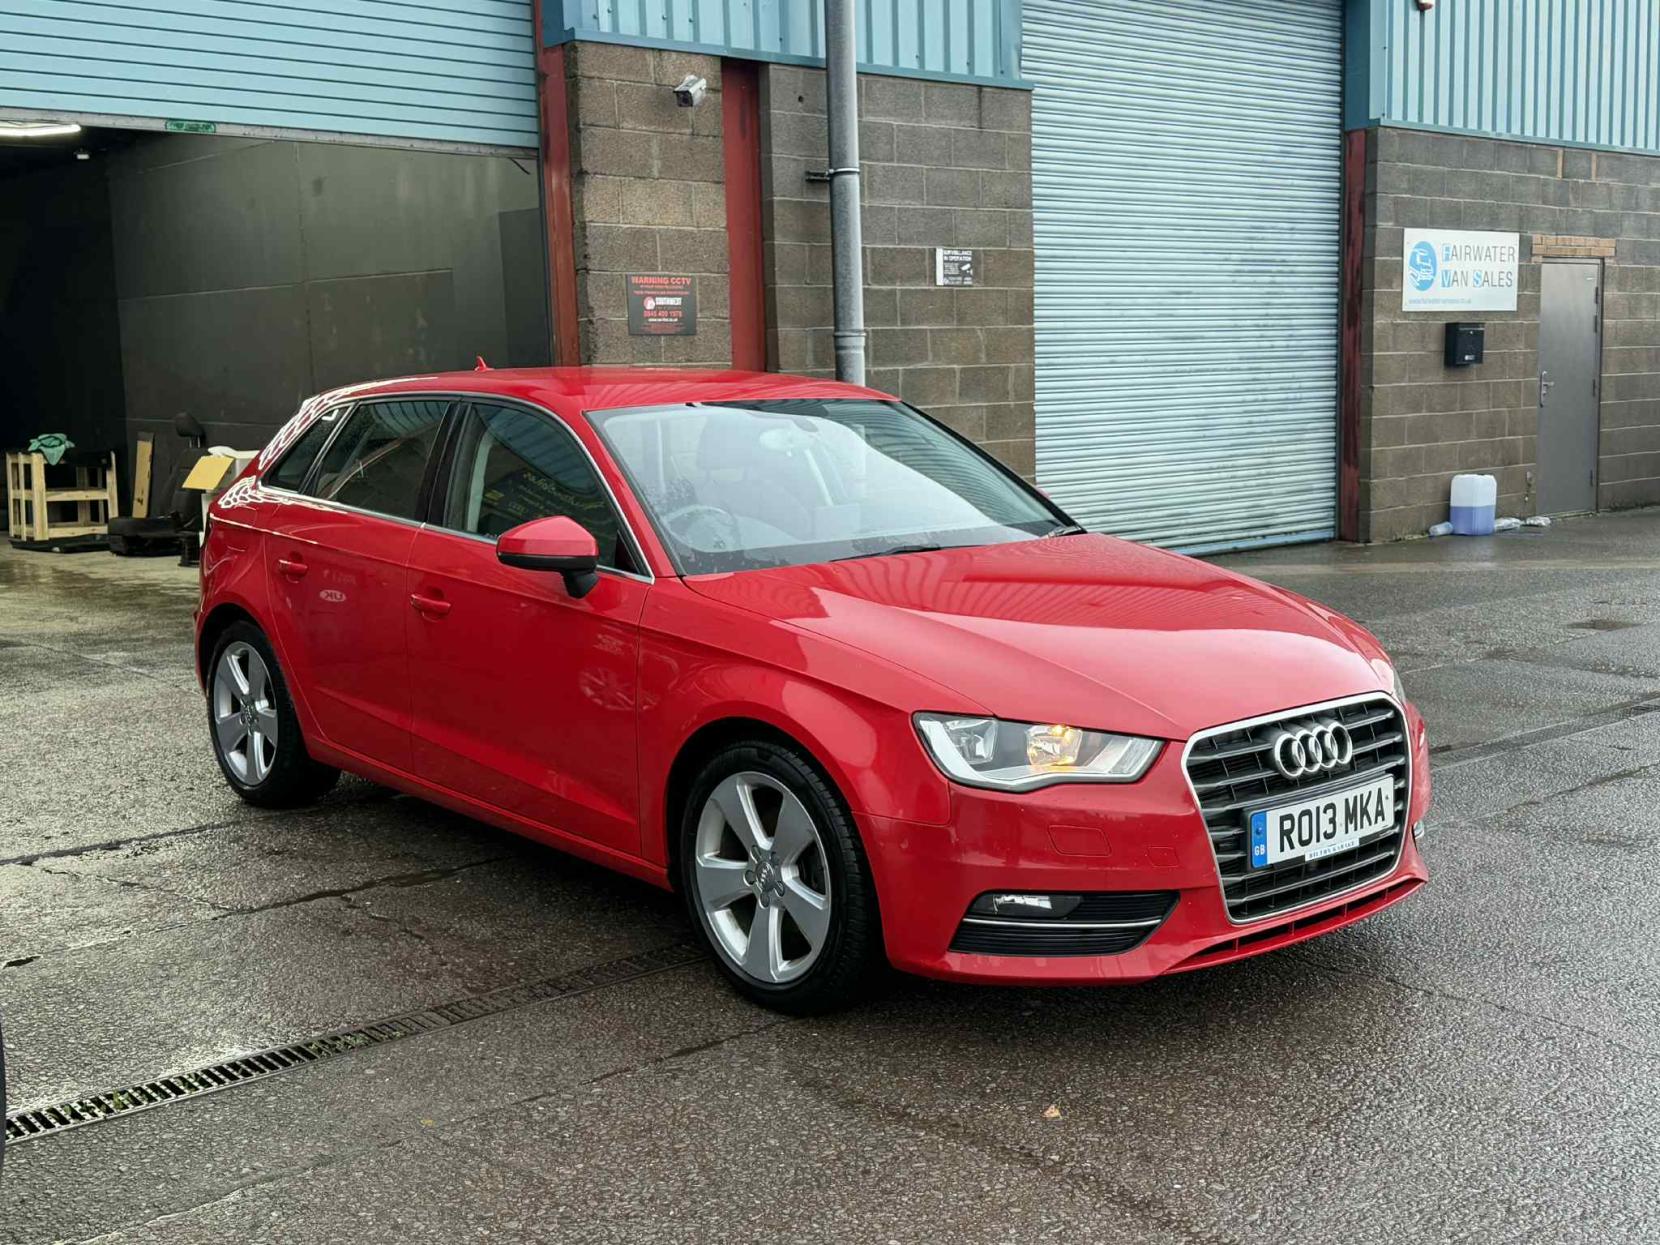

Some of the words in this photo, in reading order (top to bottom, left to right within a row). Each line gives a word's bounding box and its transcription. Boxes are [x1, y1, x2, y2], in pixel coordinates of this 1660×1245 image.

[1441, 243, 1515, 262] FAIRWATER
[631, 275, 669, 285] WARNING
[670, 276, 692, 286] CCTV
[1441, 269, 1469, 288] VAN
[1473, 269, 1513, 288] SALES
[1279, 802, 1337, 853] RO13
[1344, 787, 1386, 834] MKA
[1254, 844, 1266, 857] GB
